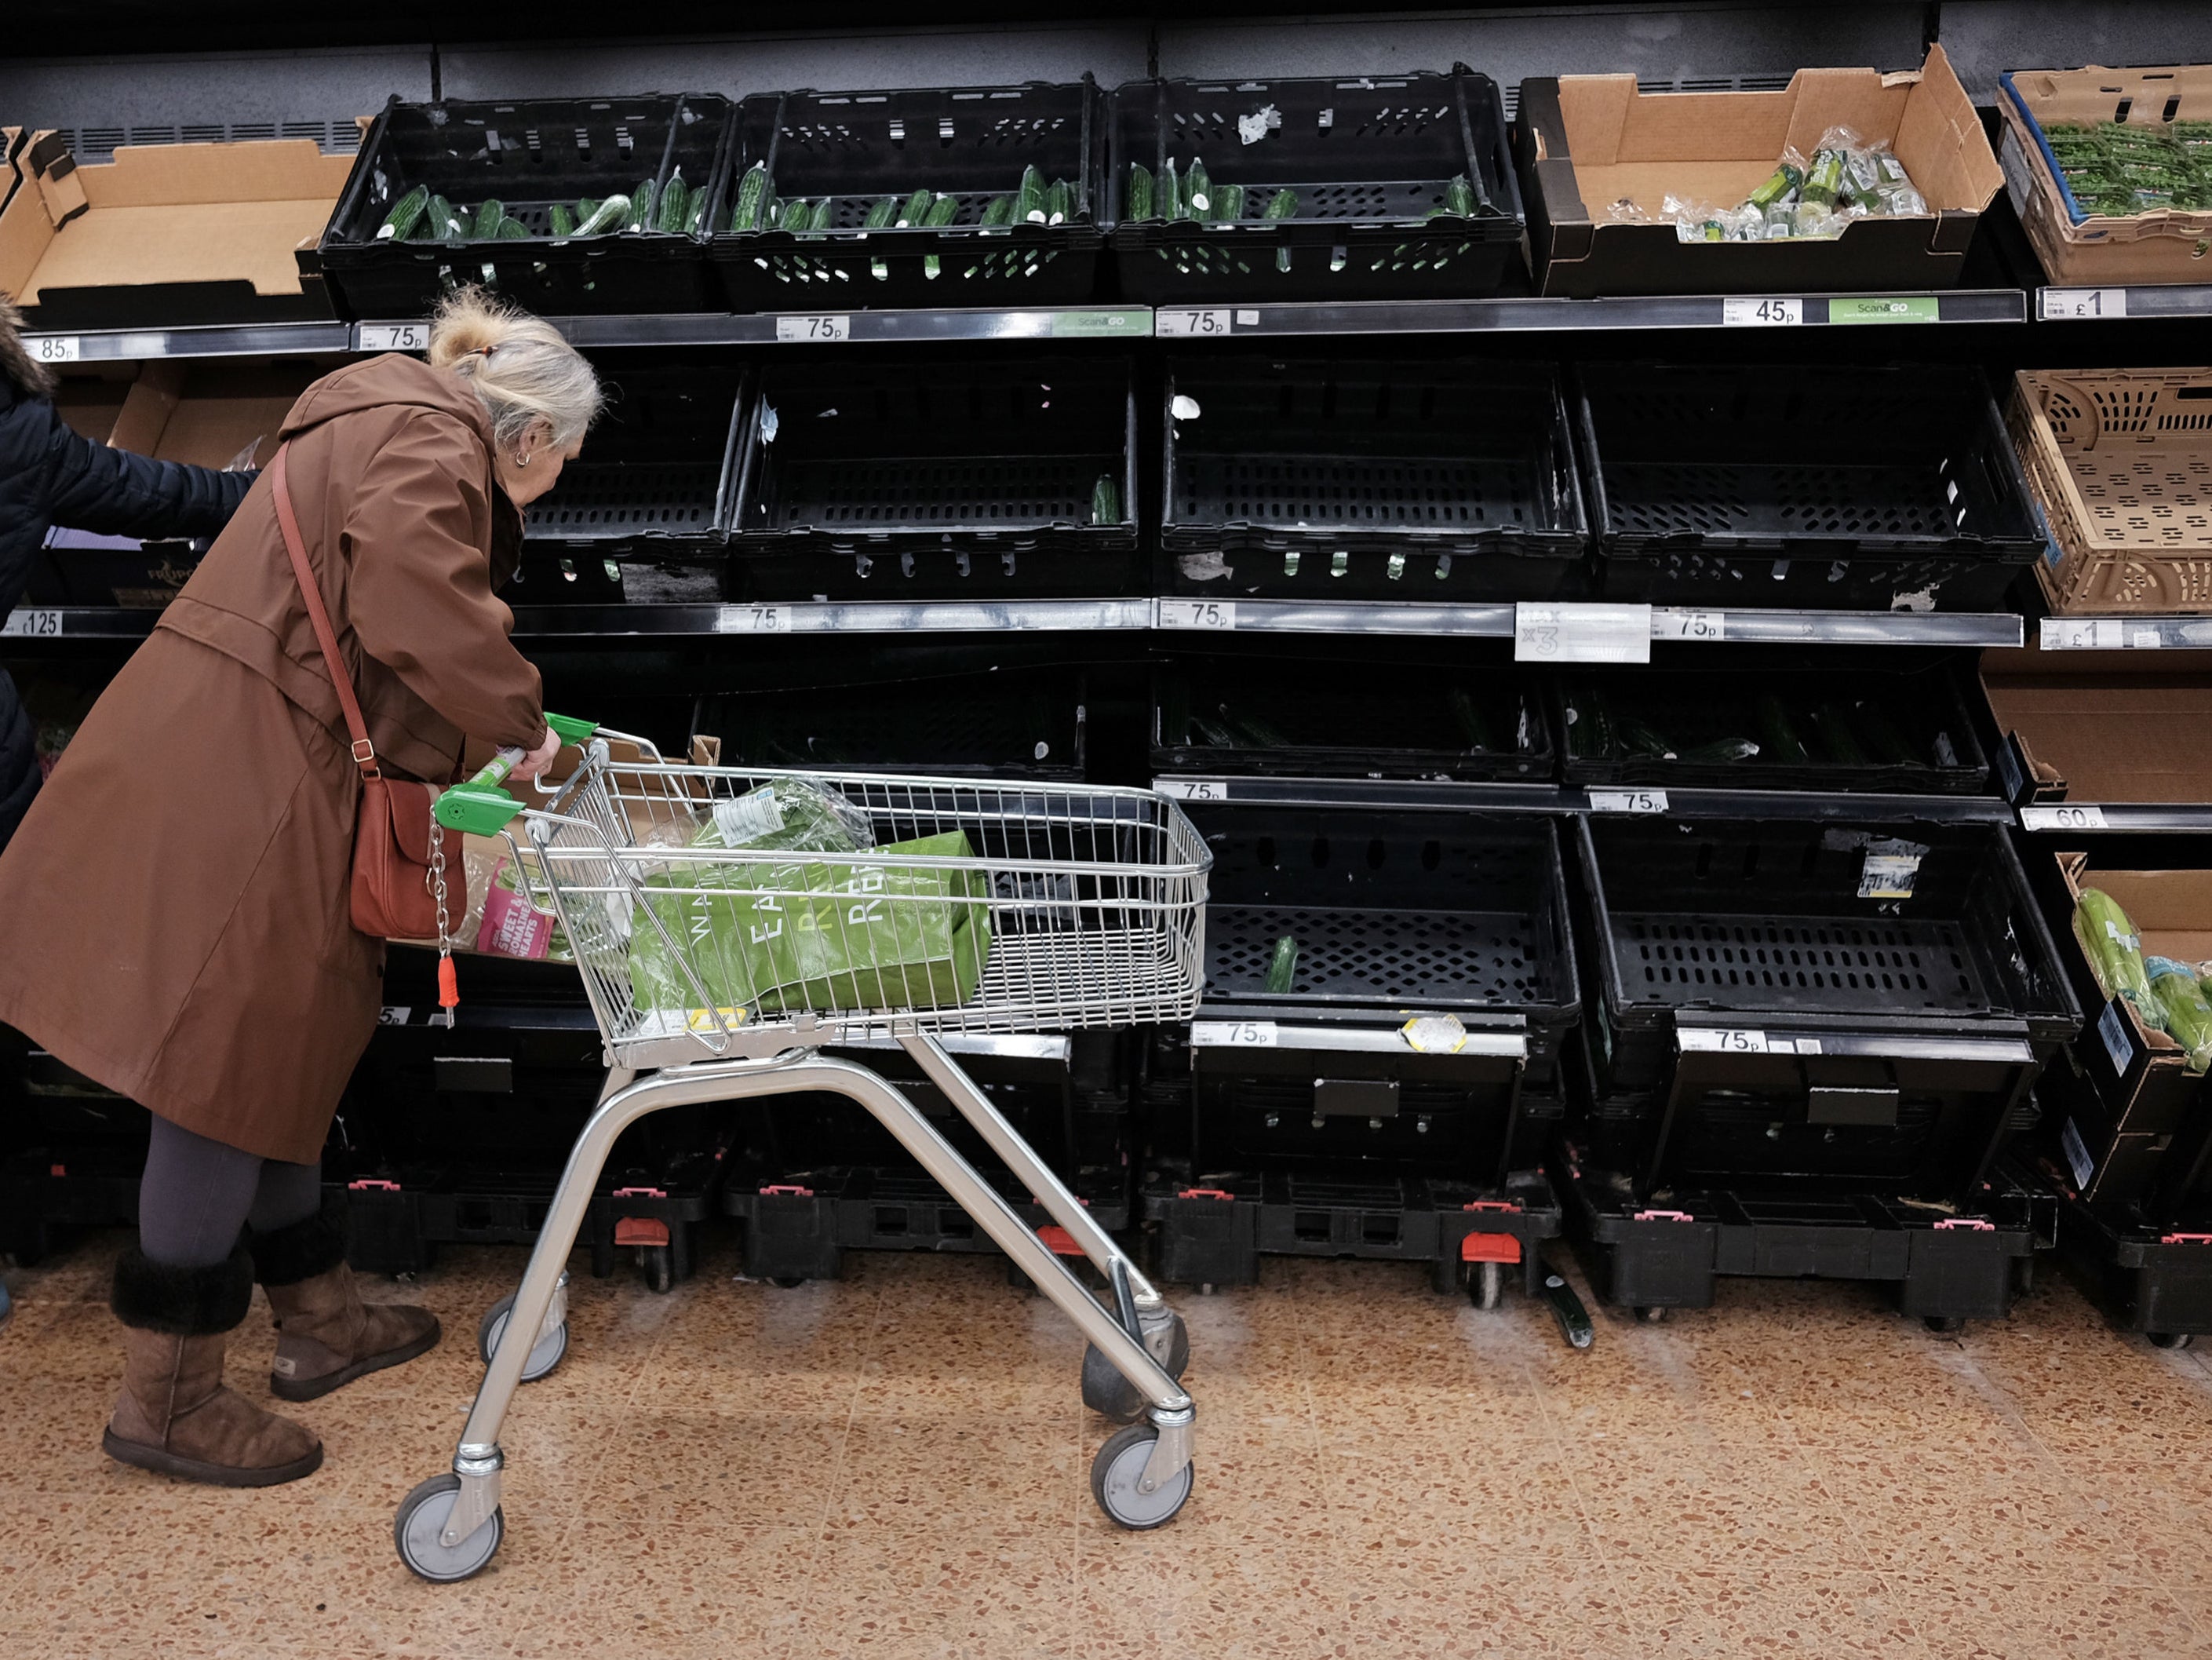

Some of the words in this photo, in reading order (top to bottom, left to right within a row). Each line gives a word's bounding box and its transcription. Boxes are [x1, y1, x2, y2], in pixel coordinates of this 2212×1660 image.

[1756, 301, 1794, 323] 45p
[2075, 291, 2102, 316] £1
[807, 318, 842, 340] 75p
[1187, 312, 1223, 334] 75p
[389, 327, 421, 349] 75p
[42, 339, 73, 360] 85p
[751, 609, 785, 631] 75p
[1192, 604, 1227, 627] 75p
[1680, 615, 1716, 639] 75p
[2072, 622, 2098, 647] £1
[1184, 783, 1219, 800] 75p
[1623, 794, 1662, 812] 75p
[2057, 809, 2097, 826] 60p
[498, 908, 519, 952] SWEET
[510, 898, 523, 908] &
[519, 918, 538, 958] HEARTS
[1227, 1023, 1268, 1045] 75p
[1715, 1031, 1759, 1053] 75p
